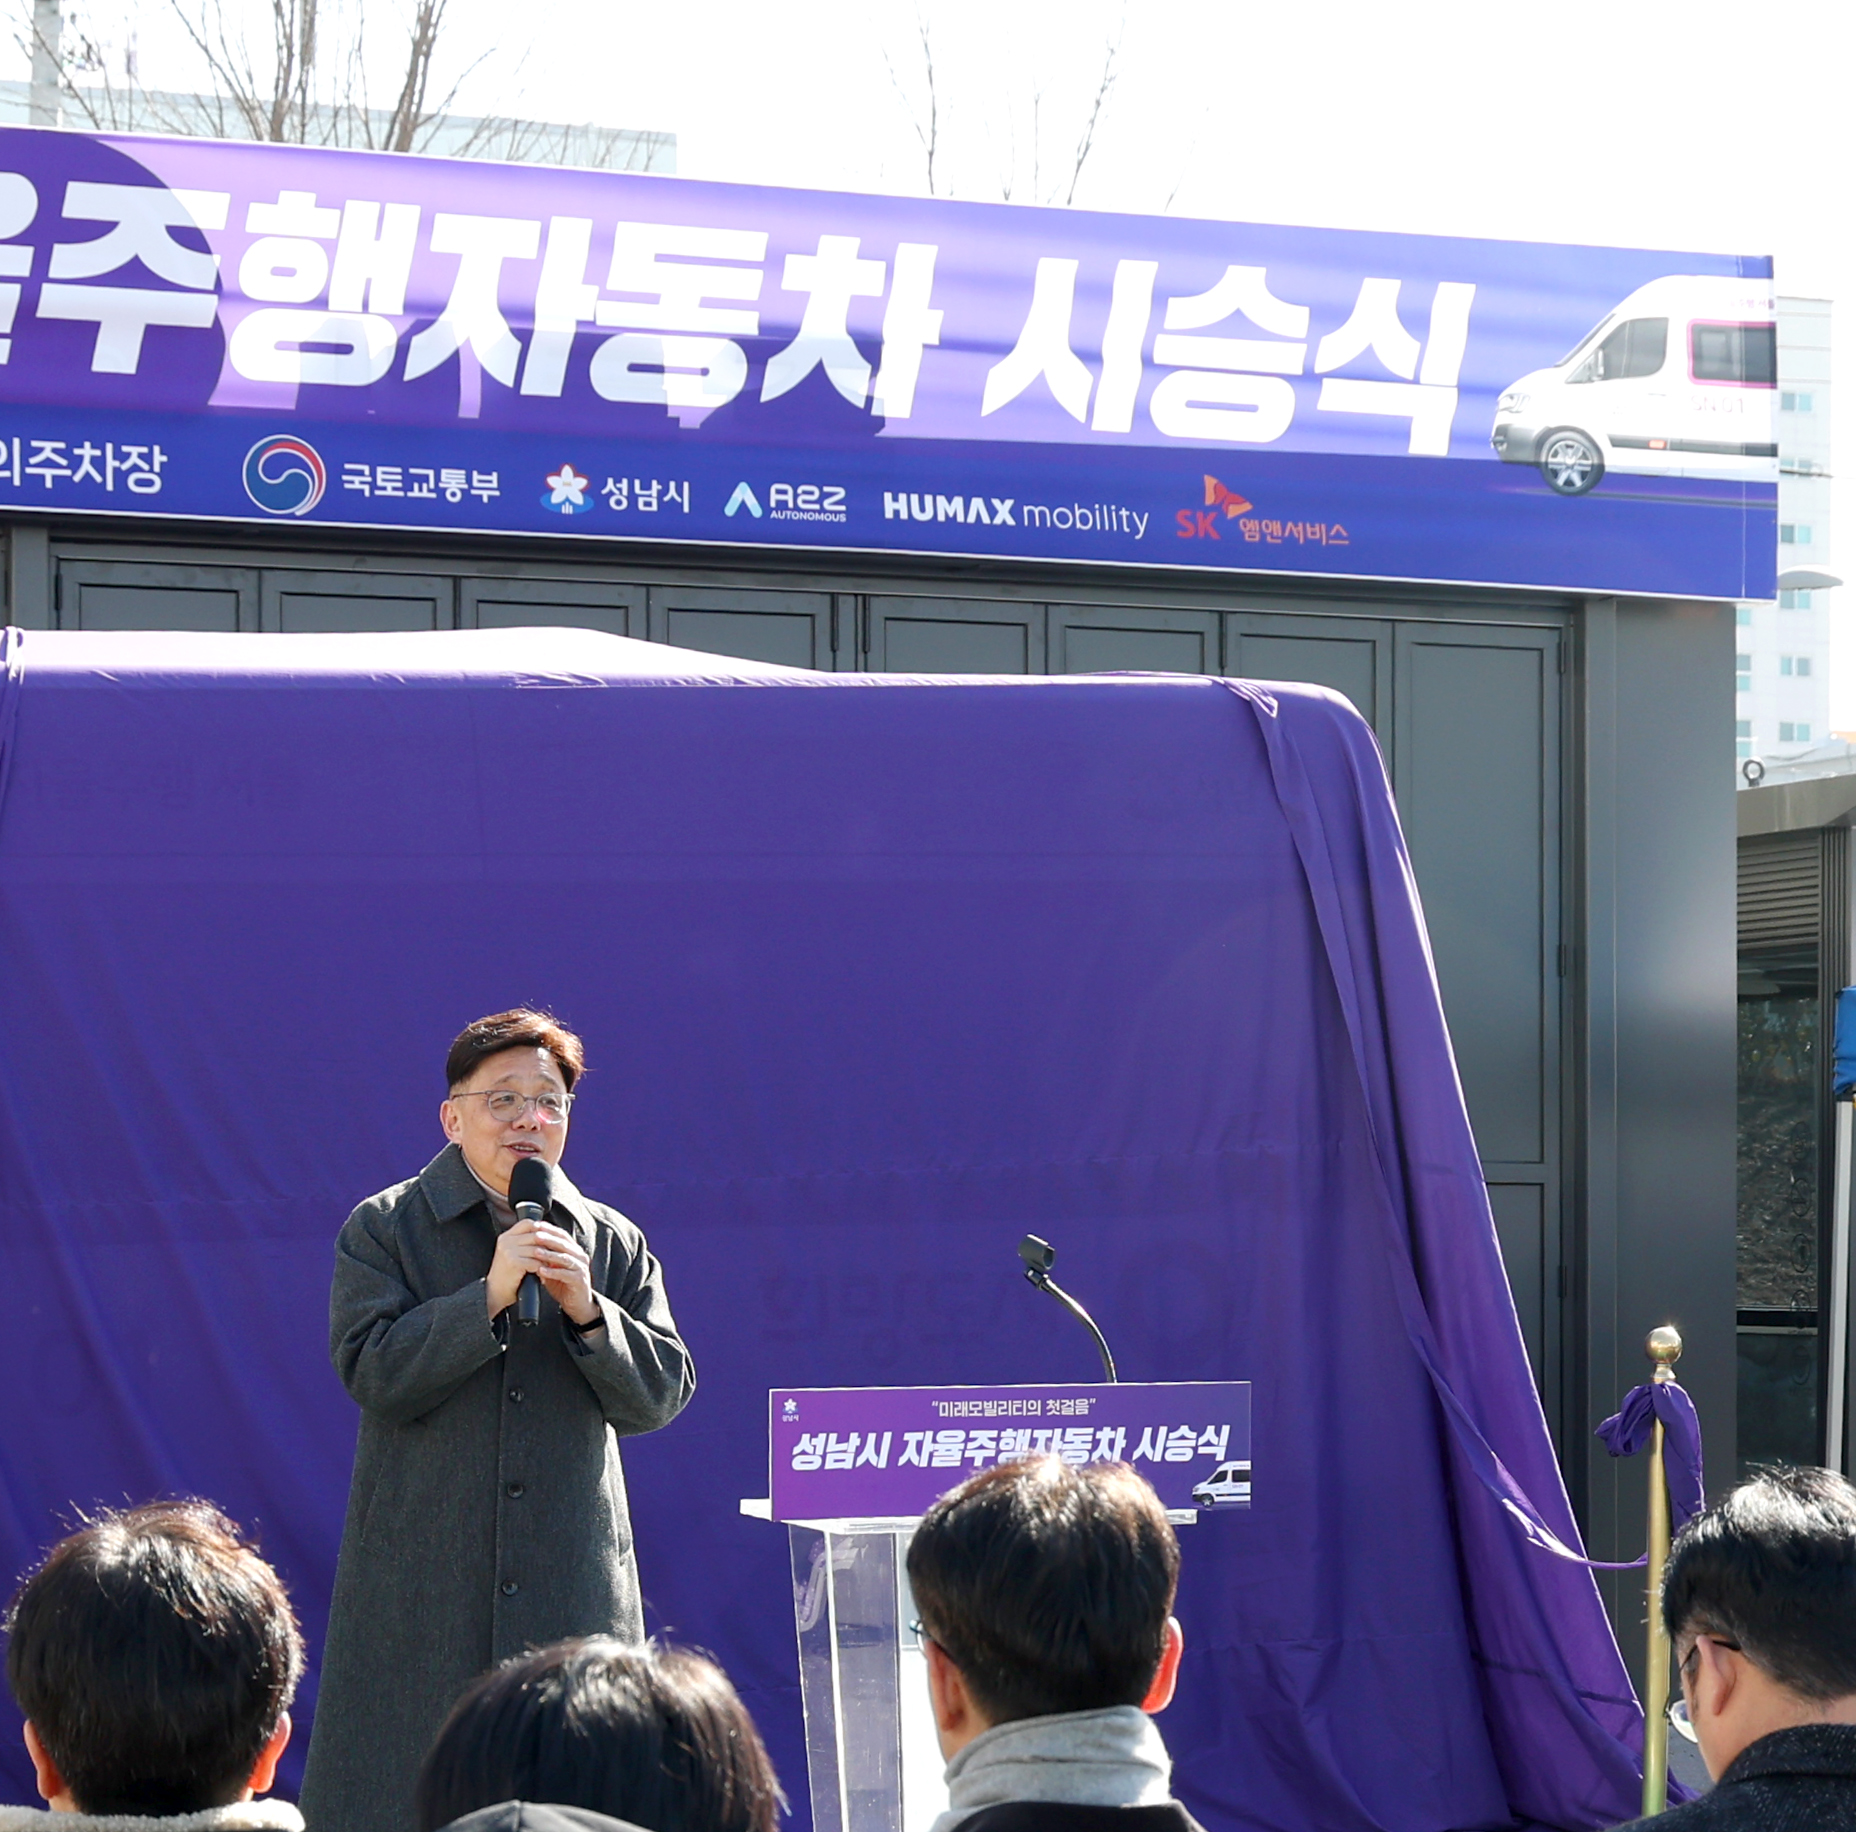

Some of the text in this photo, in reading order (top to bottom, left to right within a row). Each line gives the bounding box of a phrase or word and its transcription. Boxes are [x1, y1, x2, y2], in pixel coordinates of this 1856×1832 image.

[980, 256, 1477, 457] 시승식
[341, 463, 501, 504] 국토교통부
[600, 477, 690, 514] 성남시
[770, 509, 847, 522] AUTONOMOUS
[883, 491, 1149, 540] HUMAX mobility
[1175, 508, 1350, 545] SK 엠앤서비스
[791, 1424, 1231, 1471] 성남시 자율주행자동차 시승식
